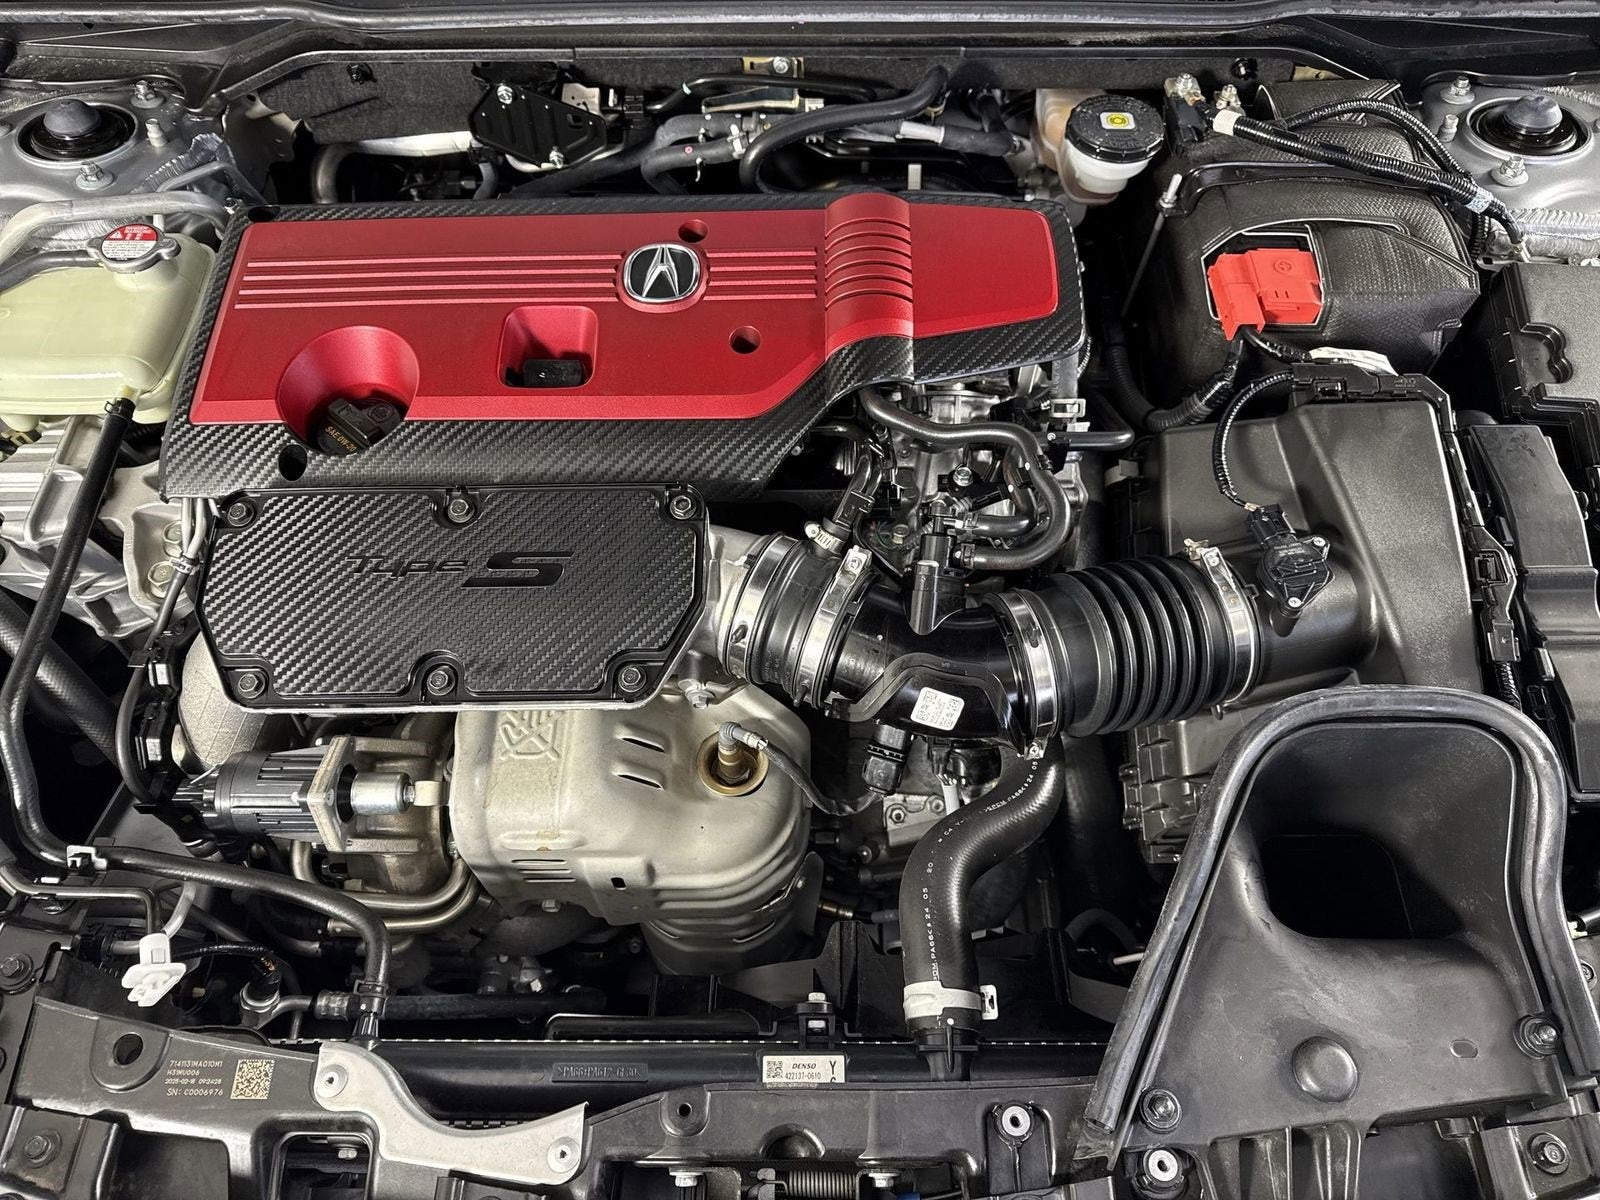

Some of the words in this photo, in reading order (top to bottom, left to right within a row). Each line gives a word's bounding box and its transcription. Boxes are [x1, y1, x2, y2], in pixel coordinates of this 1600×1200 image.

[346, 556, 469, 578] Type
[461, 551, 575, 590] S
[922, 887, 929, 899] 05
[829, 1060, 837, 1075] Y
[785, 1072, 822, 1080] 422137-0610
